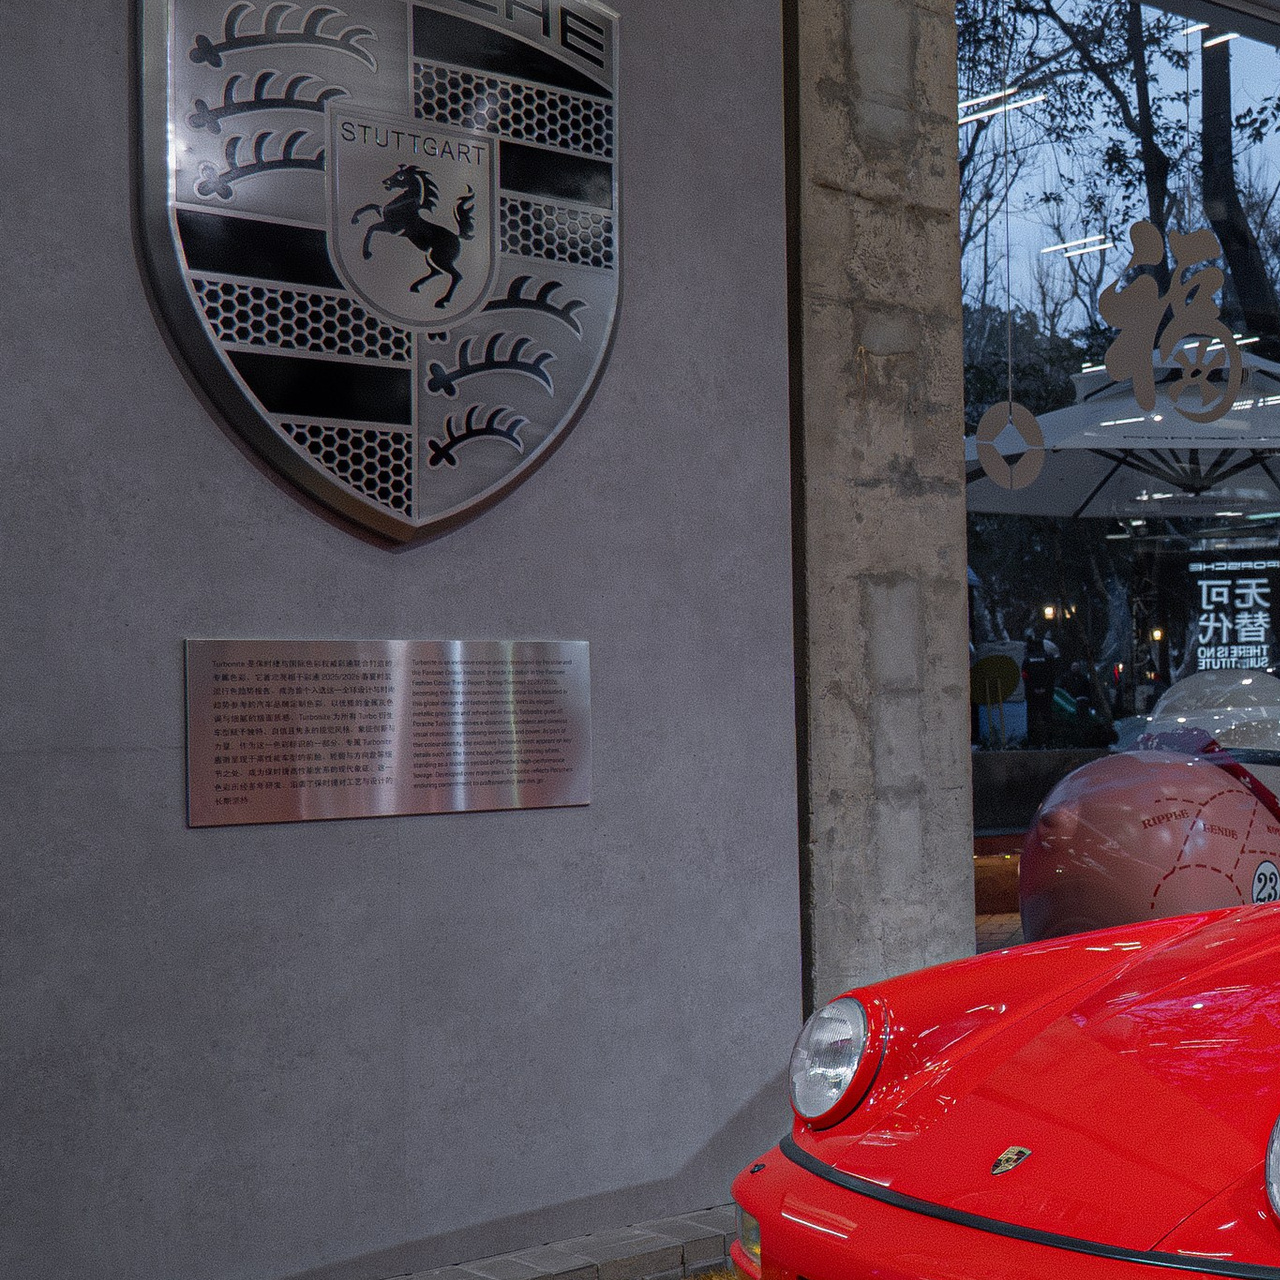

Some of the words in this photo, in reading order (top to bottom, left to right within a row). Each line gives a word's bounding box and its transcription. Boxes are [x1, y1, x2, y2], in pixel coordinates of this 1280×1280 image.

[340, 120, 487, 166] STUTTGART
[1141, 808, 1190, 830] RIPPLE
[1202, 823, 1239, 841] LENDE
[1256, 872, 1278, 903] 23
